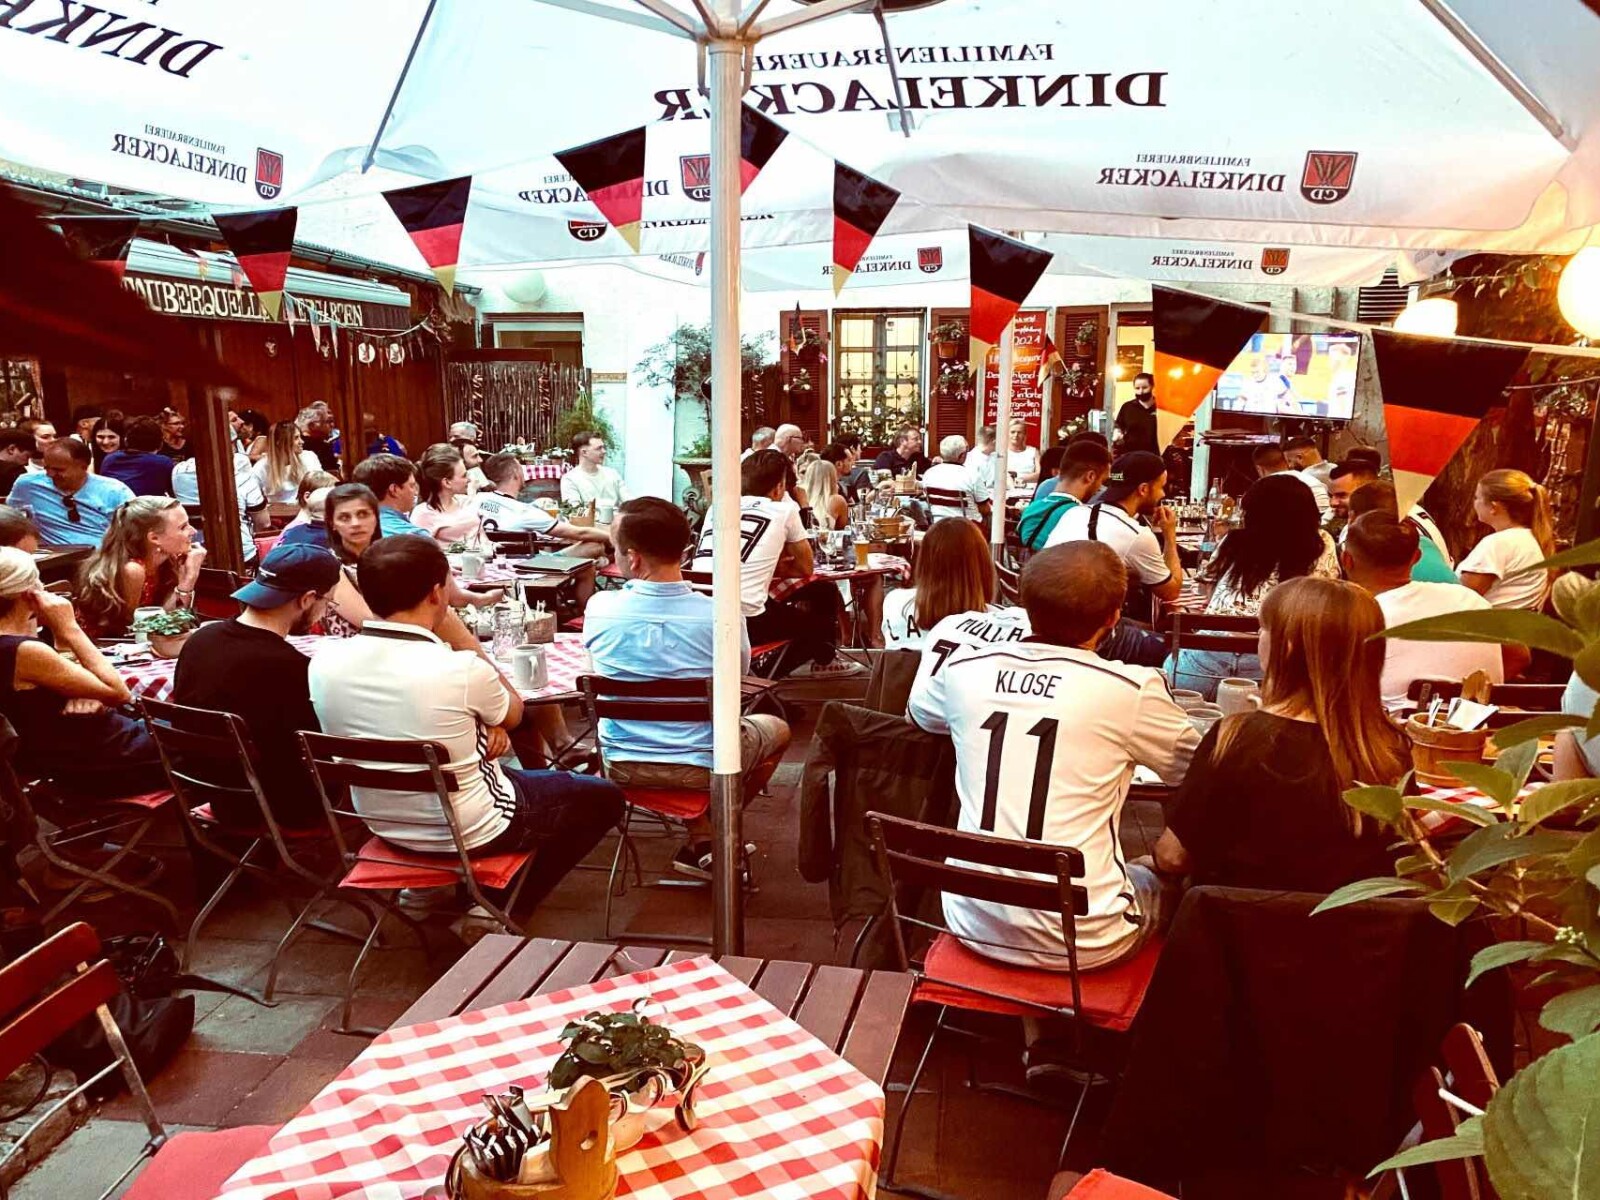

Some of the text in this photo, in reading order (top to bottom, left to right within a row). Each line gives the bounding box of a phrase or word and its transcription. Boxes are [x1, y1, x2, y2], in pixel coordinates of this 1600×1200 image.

[577, 228, 598, 238] CD
[995, 670, 1063, 699] KLOSE
[979, 710, 1060, 841] 11
